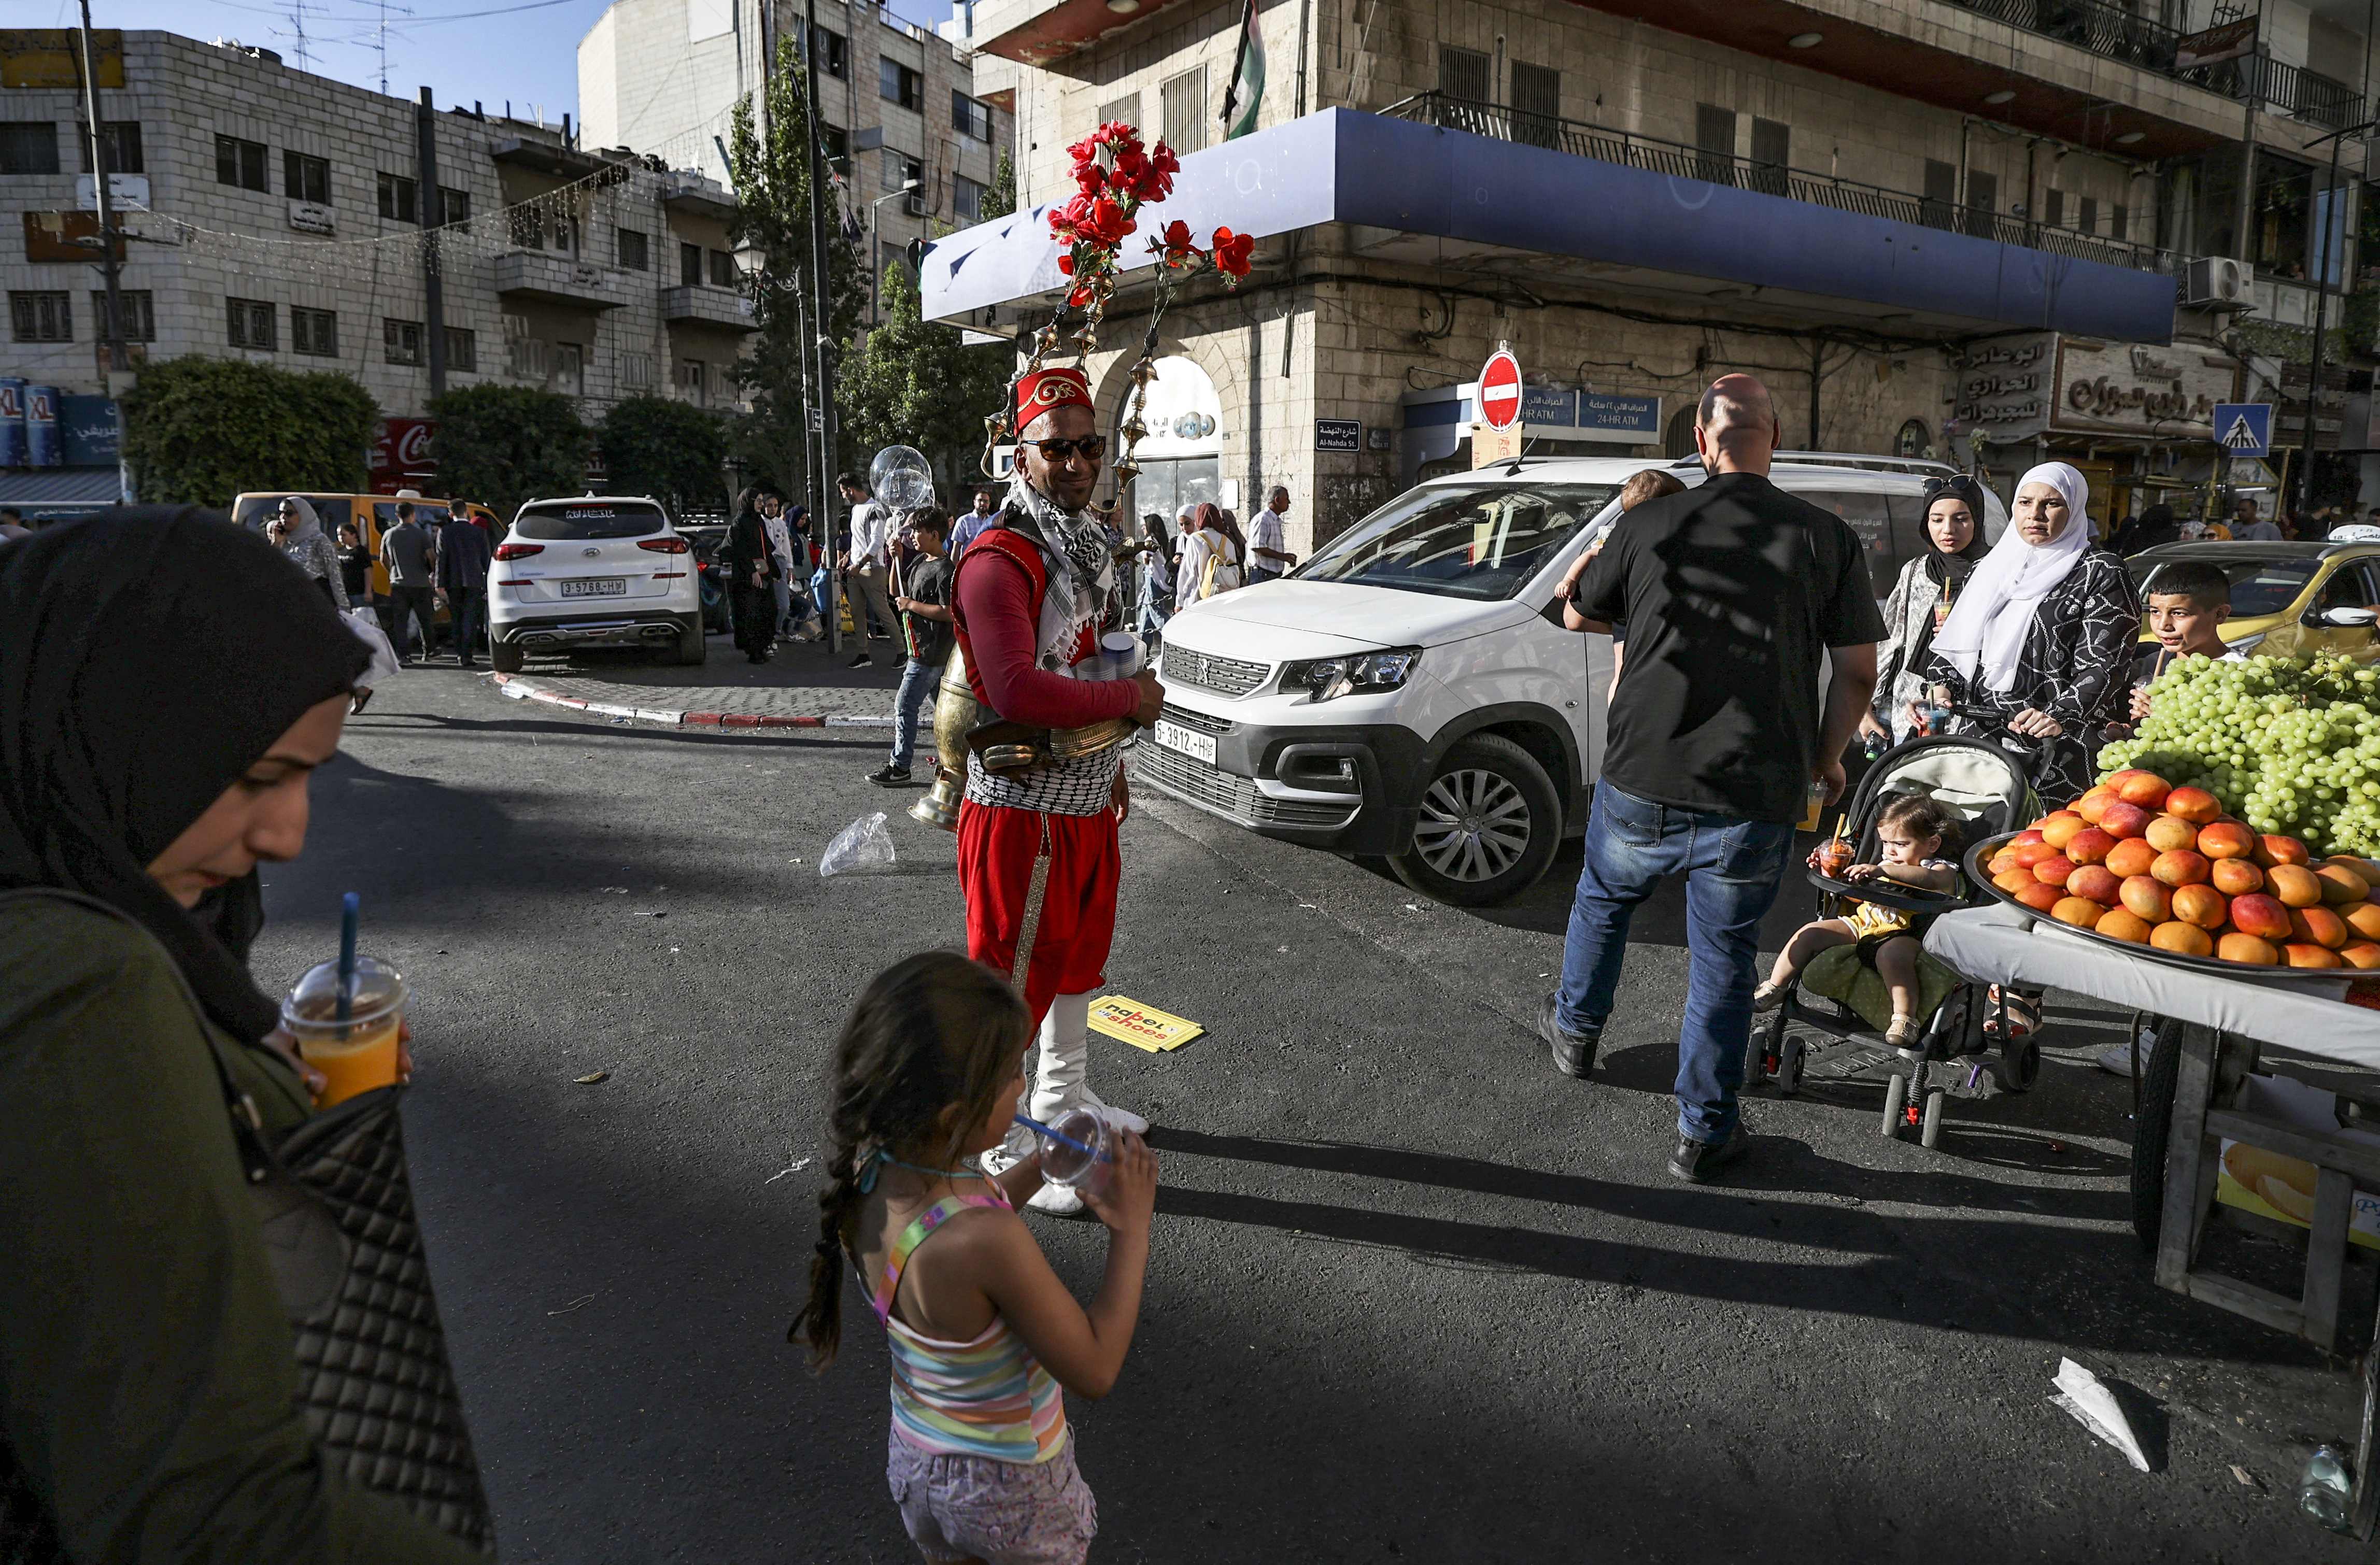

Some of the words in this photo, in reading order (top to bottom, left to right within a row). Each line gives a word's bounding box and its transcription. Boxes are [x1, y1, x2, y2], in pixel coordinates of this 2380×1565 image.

[2013, 345, 2041, 367] ابو
[1543, 397, 1564, 406] الصراف
[1589, 400, 1606, 409] ساعة
[28, 395, 54, 420] XL
[1628, 404, 1648, 412] الصراف
[1958, 402, 2039, 423] للمجوهرات
[1536, 409, 1554, 420] ATM
[1597, 414, 1621, 424] 24-HR
[1622, 416, 1638, 425] ATM
[1320, 425, 1342, 436] النهضة
[1342, 426, 1357, 437] شارع
[1105, 1004, 1166, 1030] nabel
[1108, 1014, 1168, 1040] shoes
